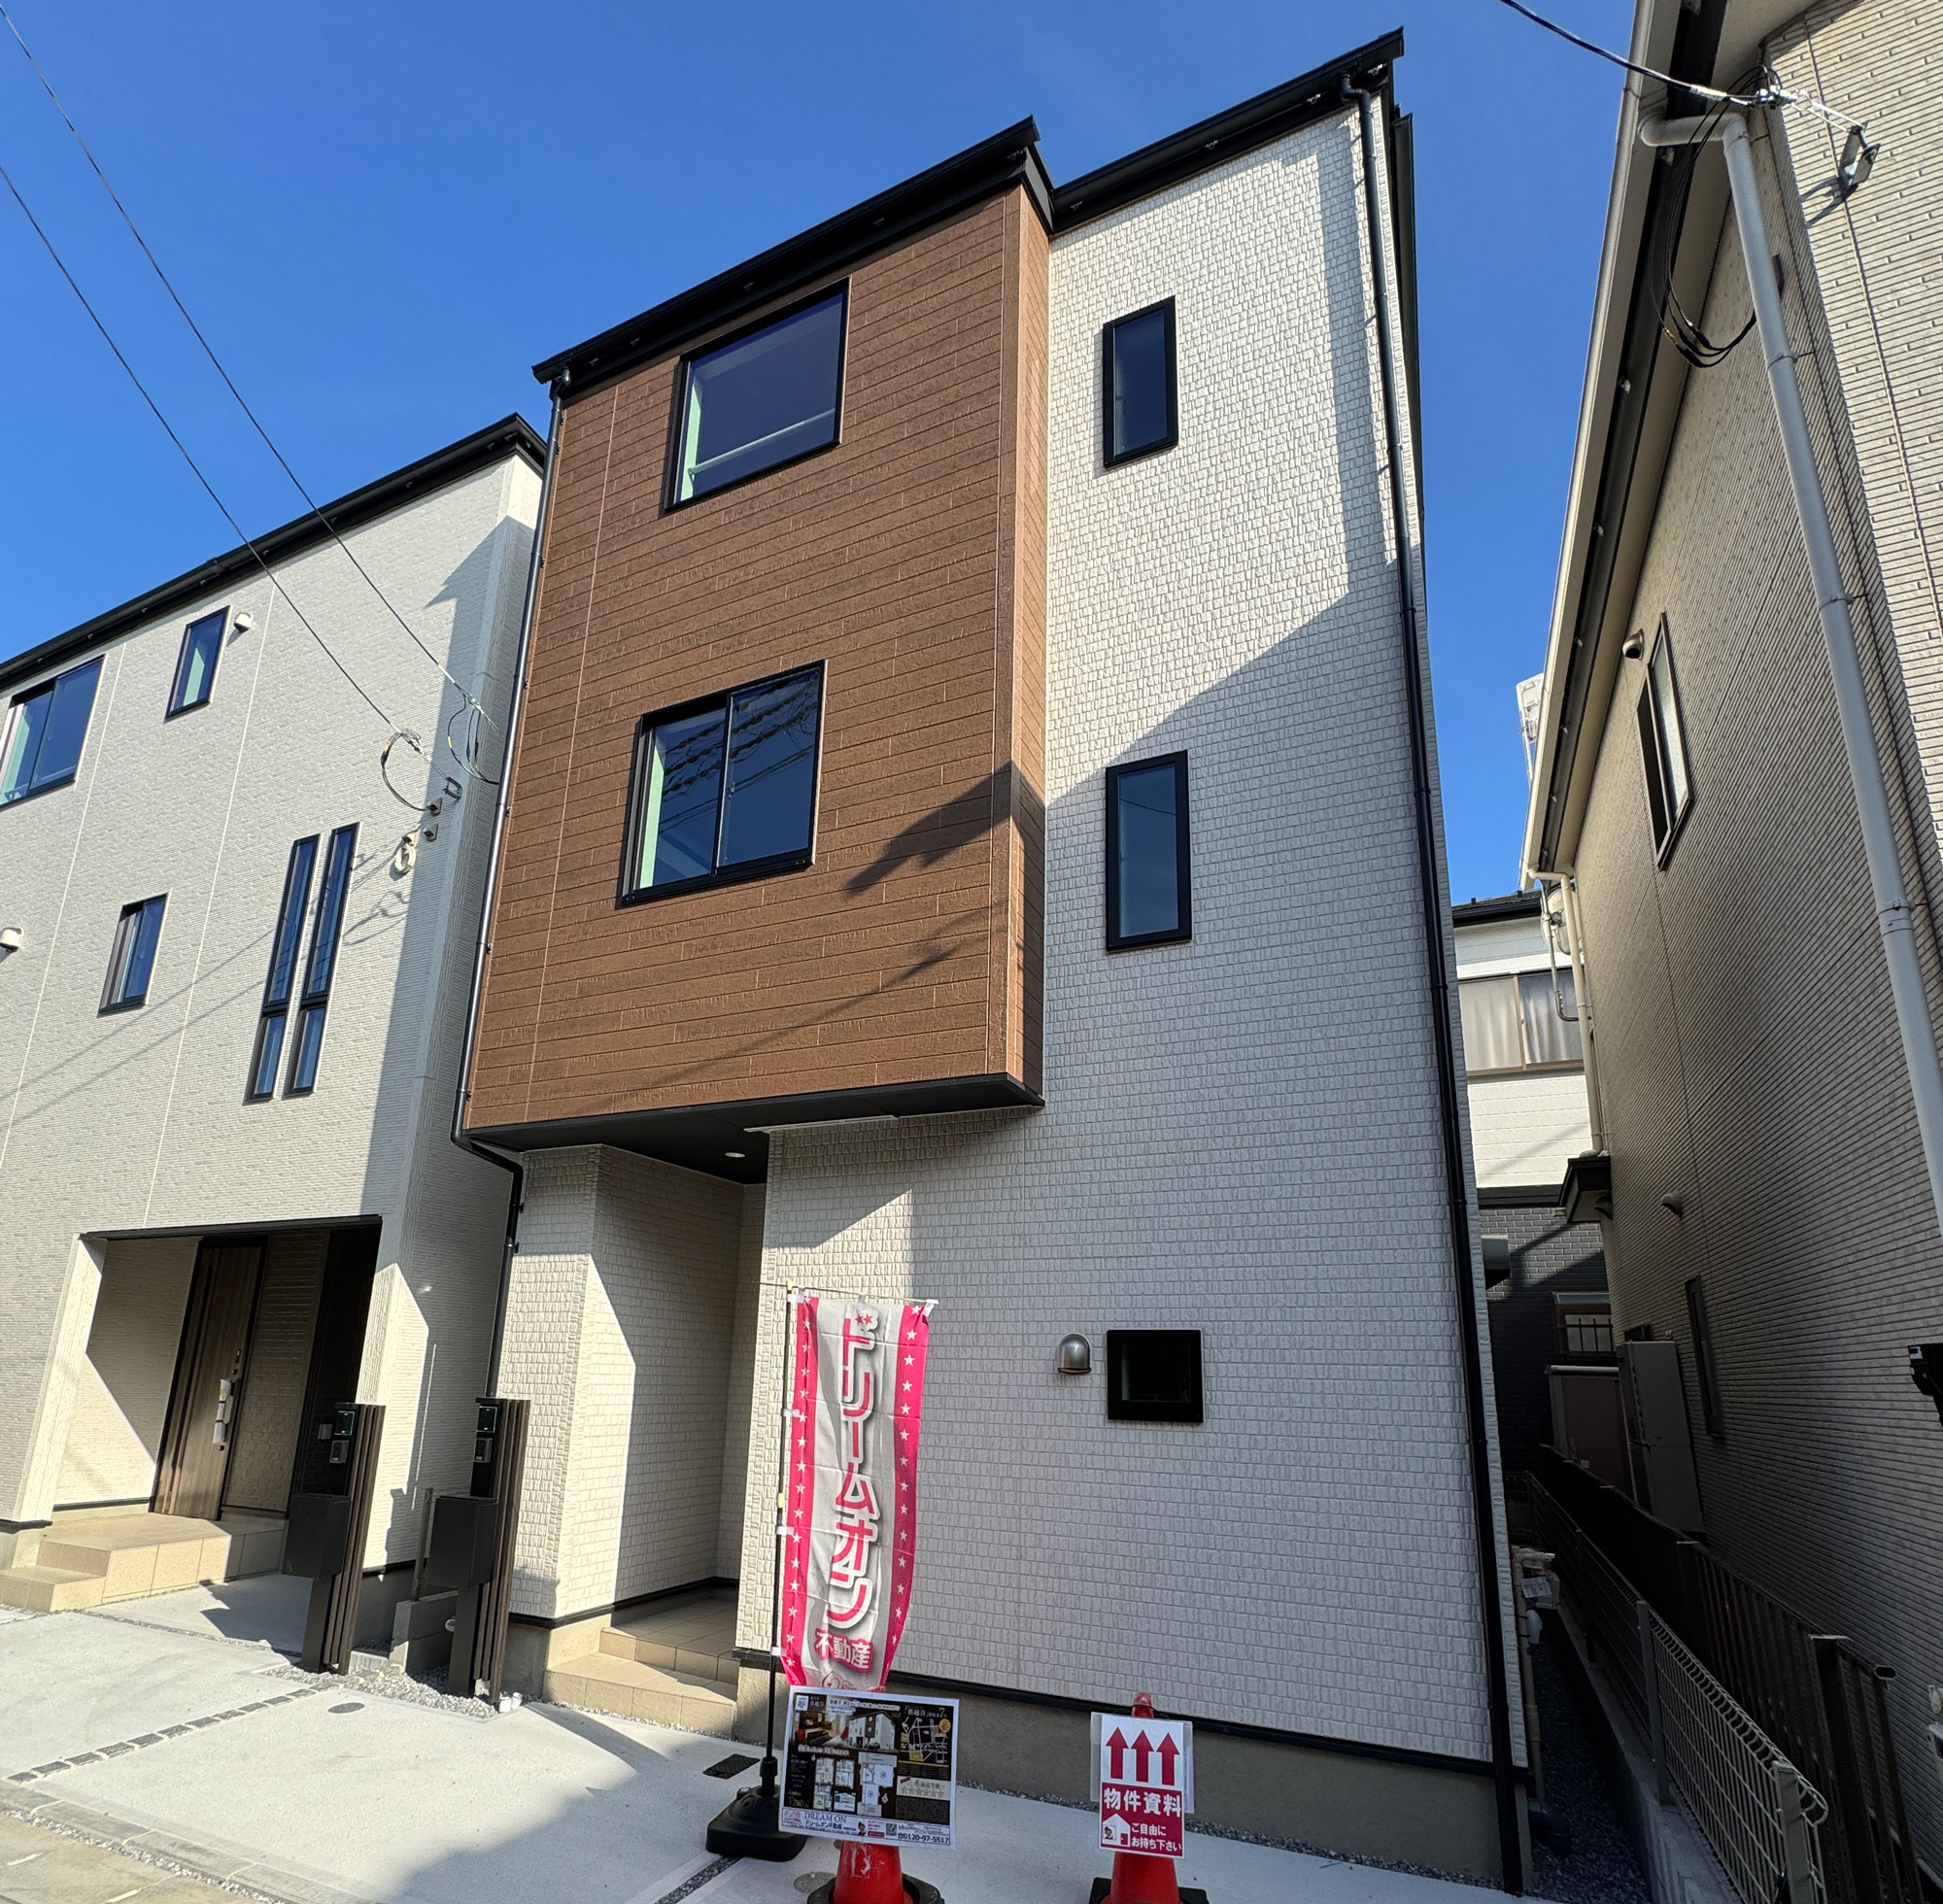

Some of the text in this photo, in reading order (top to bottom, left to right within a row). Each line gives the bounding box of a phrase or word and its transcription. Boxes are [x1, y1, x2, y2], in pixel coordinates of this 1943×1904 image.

[825, 1312, 875, 1623] ドリームオン
[815, 1631, 871, 1669] 不動産
[1104, 1788, 1181, 1818] 物件資料
[804, 1811, 833, 1822] DREAM
[835, 1815, 847, 1823] ON
[903, 1833, 949, 1843] 0120-97-5517
[1131, 1822, 1167, 1837] ご自由に
[1131, 1836, 1182, 1853] お持ち下さい
